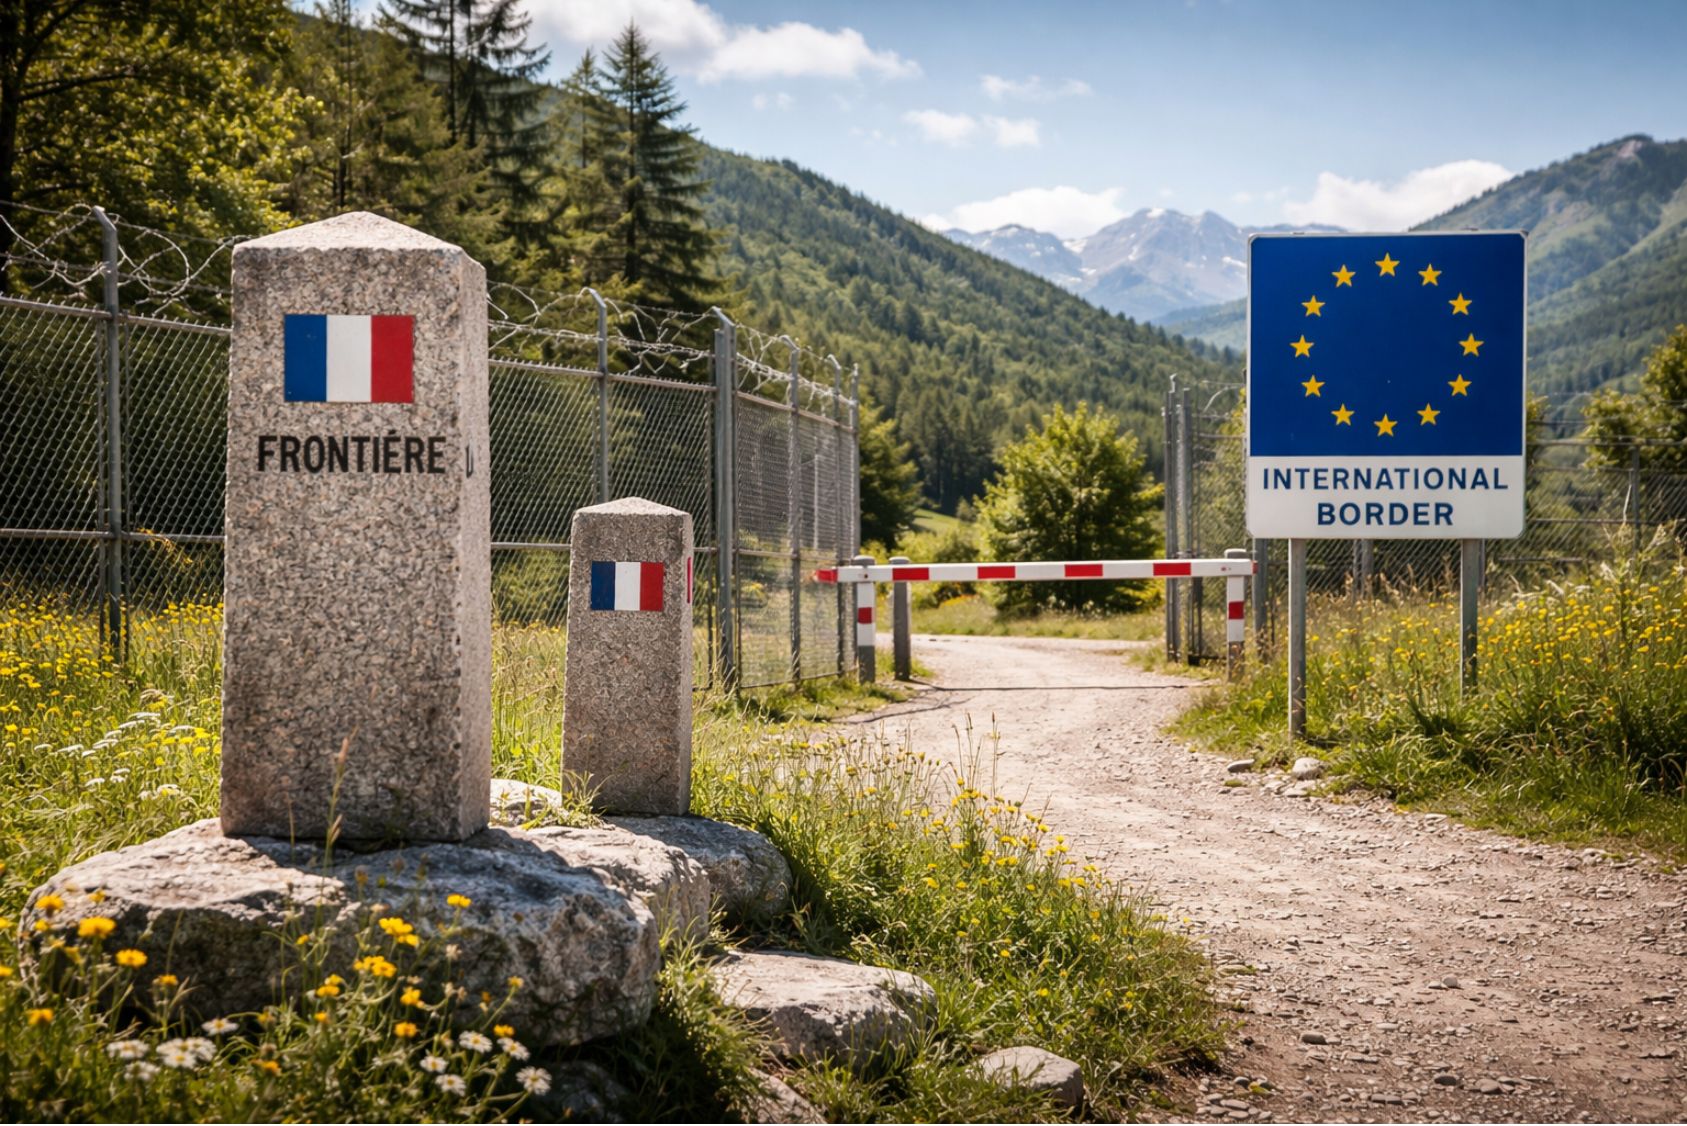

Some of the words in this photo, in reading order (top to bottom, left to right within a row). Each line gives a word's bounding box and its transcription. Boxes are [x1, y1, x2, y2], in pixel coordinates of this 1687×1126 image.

[258, 429, 446, 474] FRONTIÉRE
[1263, 467, 1508, 490] INTERNATIONAL
[1317, 502, 1454, 526] BORDER
